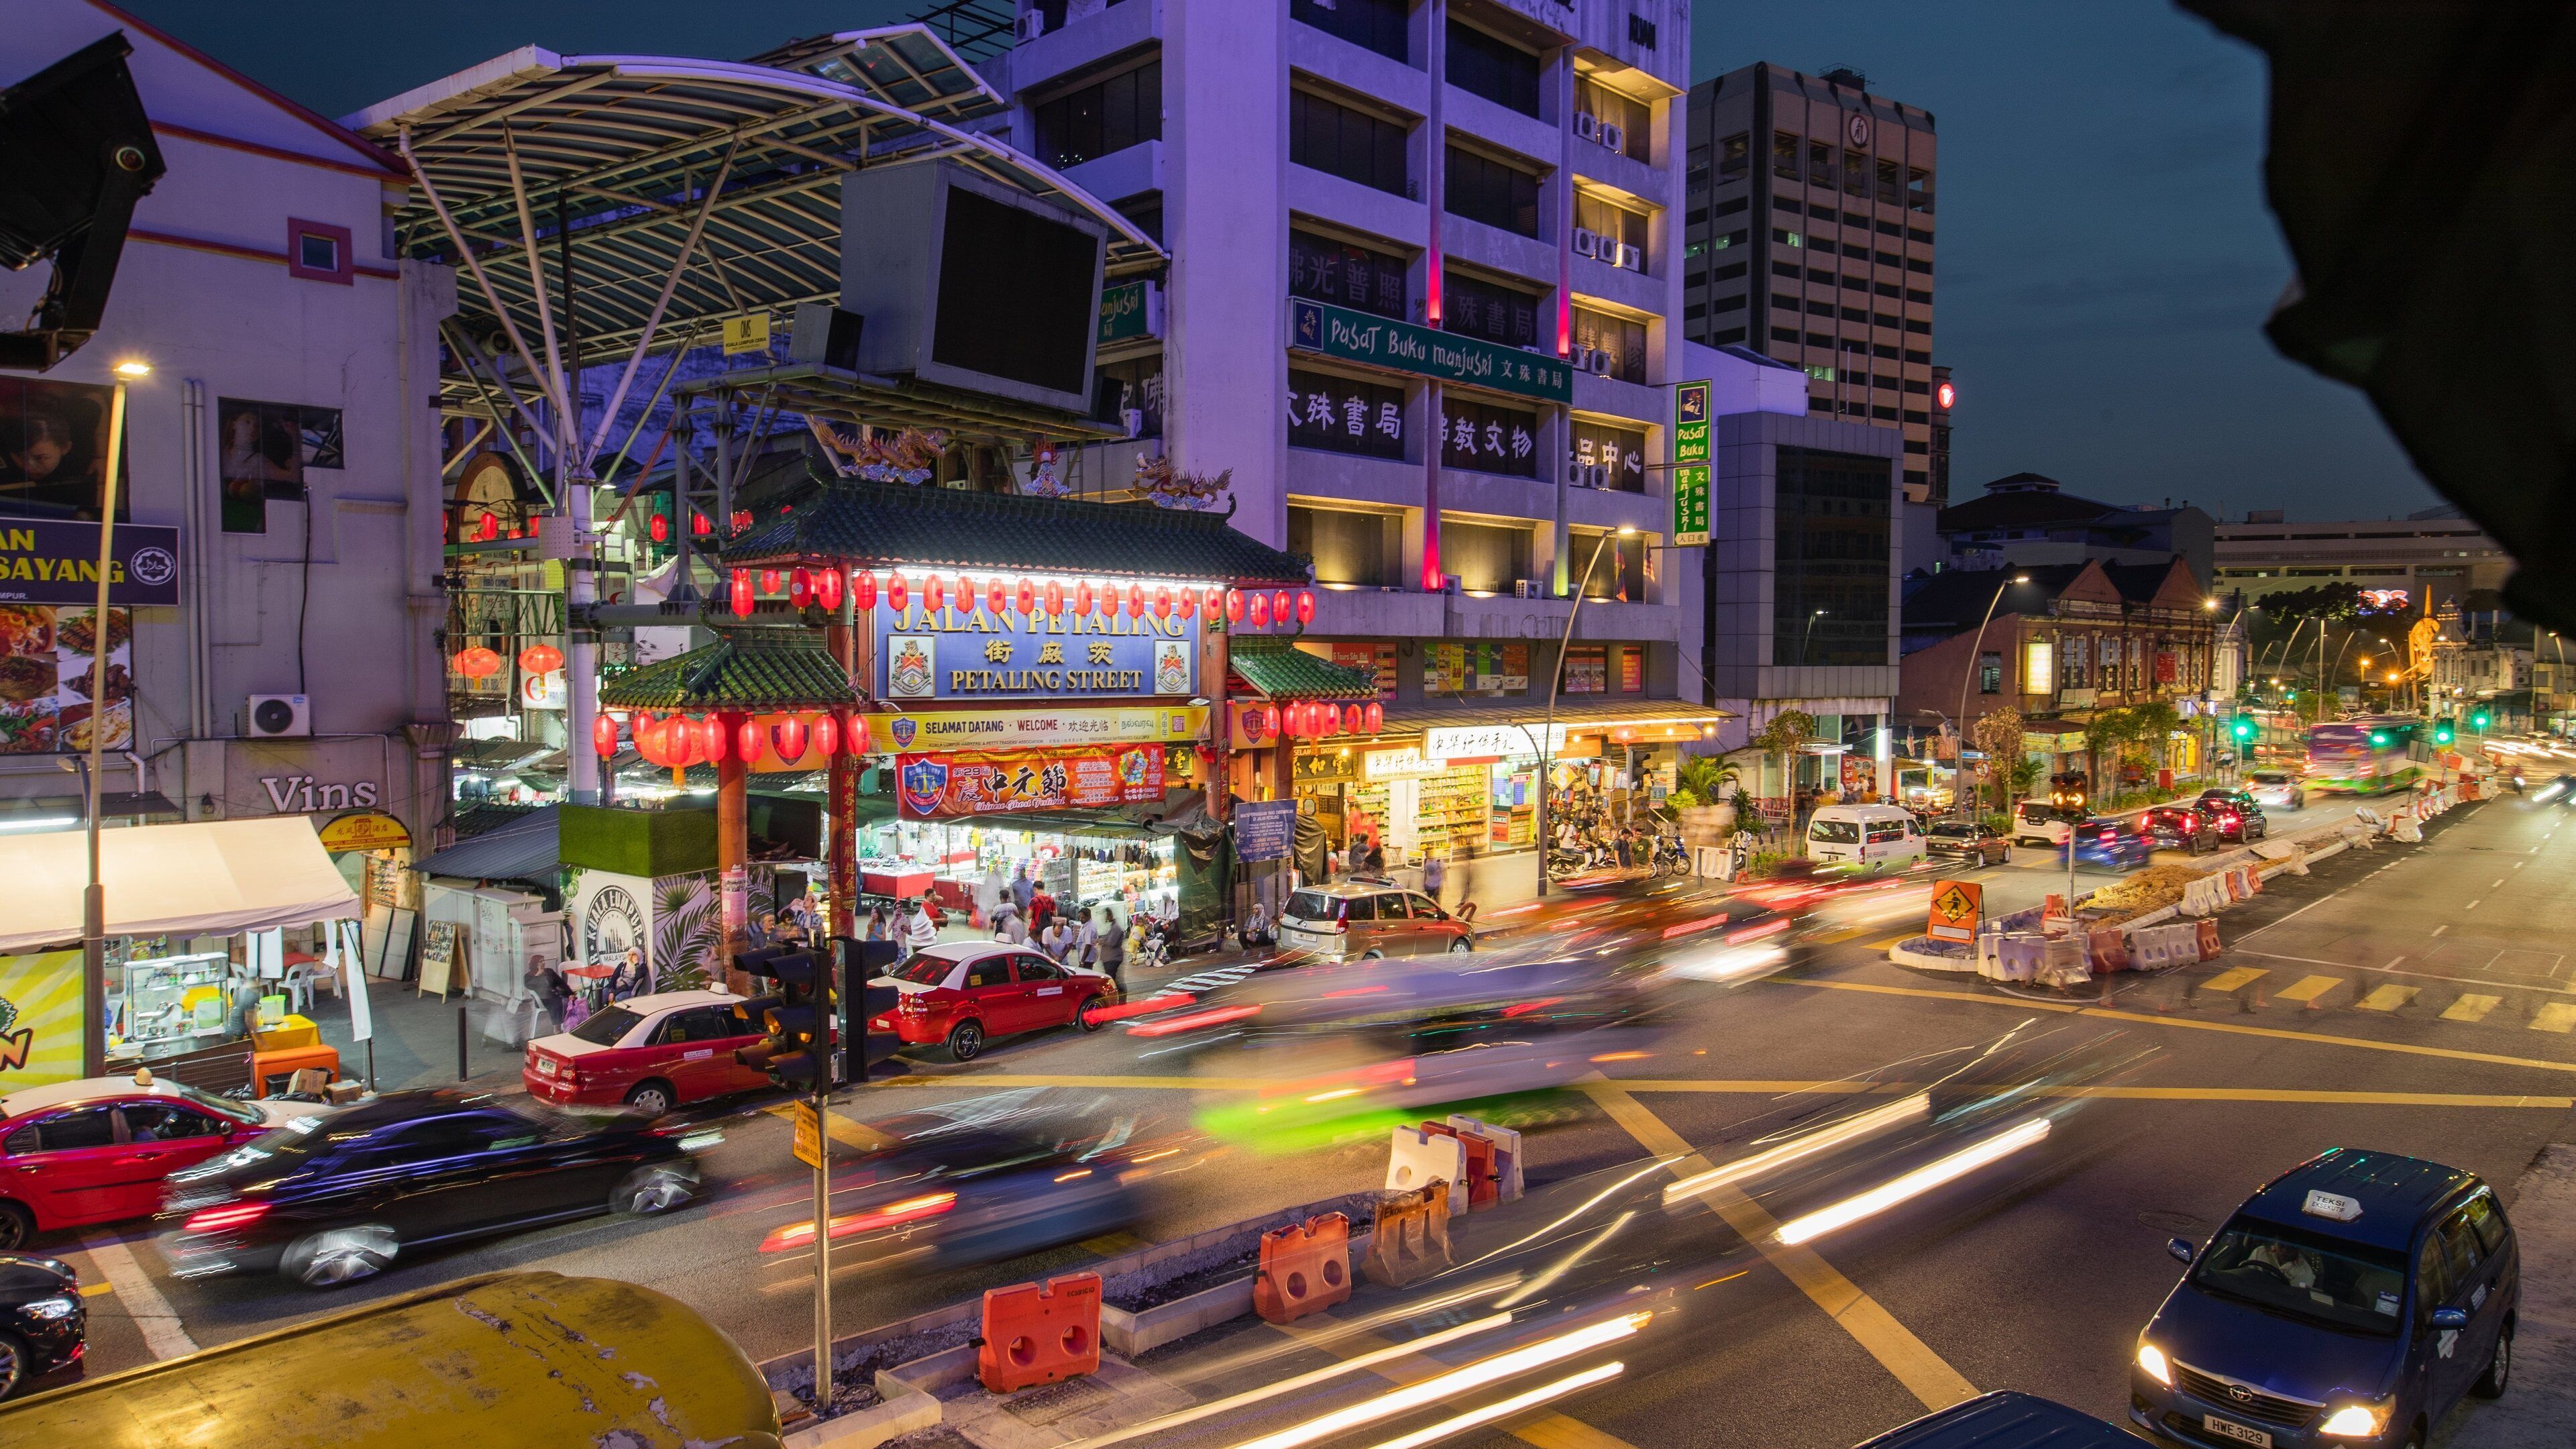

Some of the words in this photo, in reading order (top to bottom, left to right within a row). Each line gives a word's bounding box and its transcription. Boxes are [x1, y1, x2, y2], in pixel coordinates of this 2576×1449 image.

[1387, 329, 1426, 361] Buku
[1500, 360, 1564, 390] 文殊書局
[1679, 443, 1705, 457] Buku
[1695, 471, 1705, 527] 文殊書局
[894, 604, 1016, 634] JALAN
[1026, 606, 1186, 637] PETALING
[951, 669, 1061, 691] PETALING
[1067, 669, 1142, 690] STREET
[925, 721, 967, 734] SELAMAT
[969, 720, 1004, 733] DATANG
[1017, 718, 1058, 732] WELCOME
[1067, 719, 1109, 732] 欢迎光临
[260, 776, 377, 812] Vins
[974, 800, 1006, 812] Chinese
[1006, 798, 1033, 810] Ghost
[1032, 796, 1066, 808] Festival
[588, 894, 608, 941] KUALA
[608, 891, 643, 937] LUMPUR
[2312, 1201, 2346, 1213] EKSEKUTIF
[2316, 1195, 2345, 1207] TEKSI
[2212, 1419, 2235, 1436] HWE
[2237, 1427, 2263, 1444] 3129
